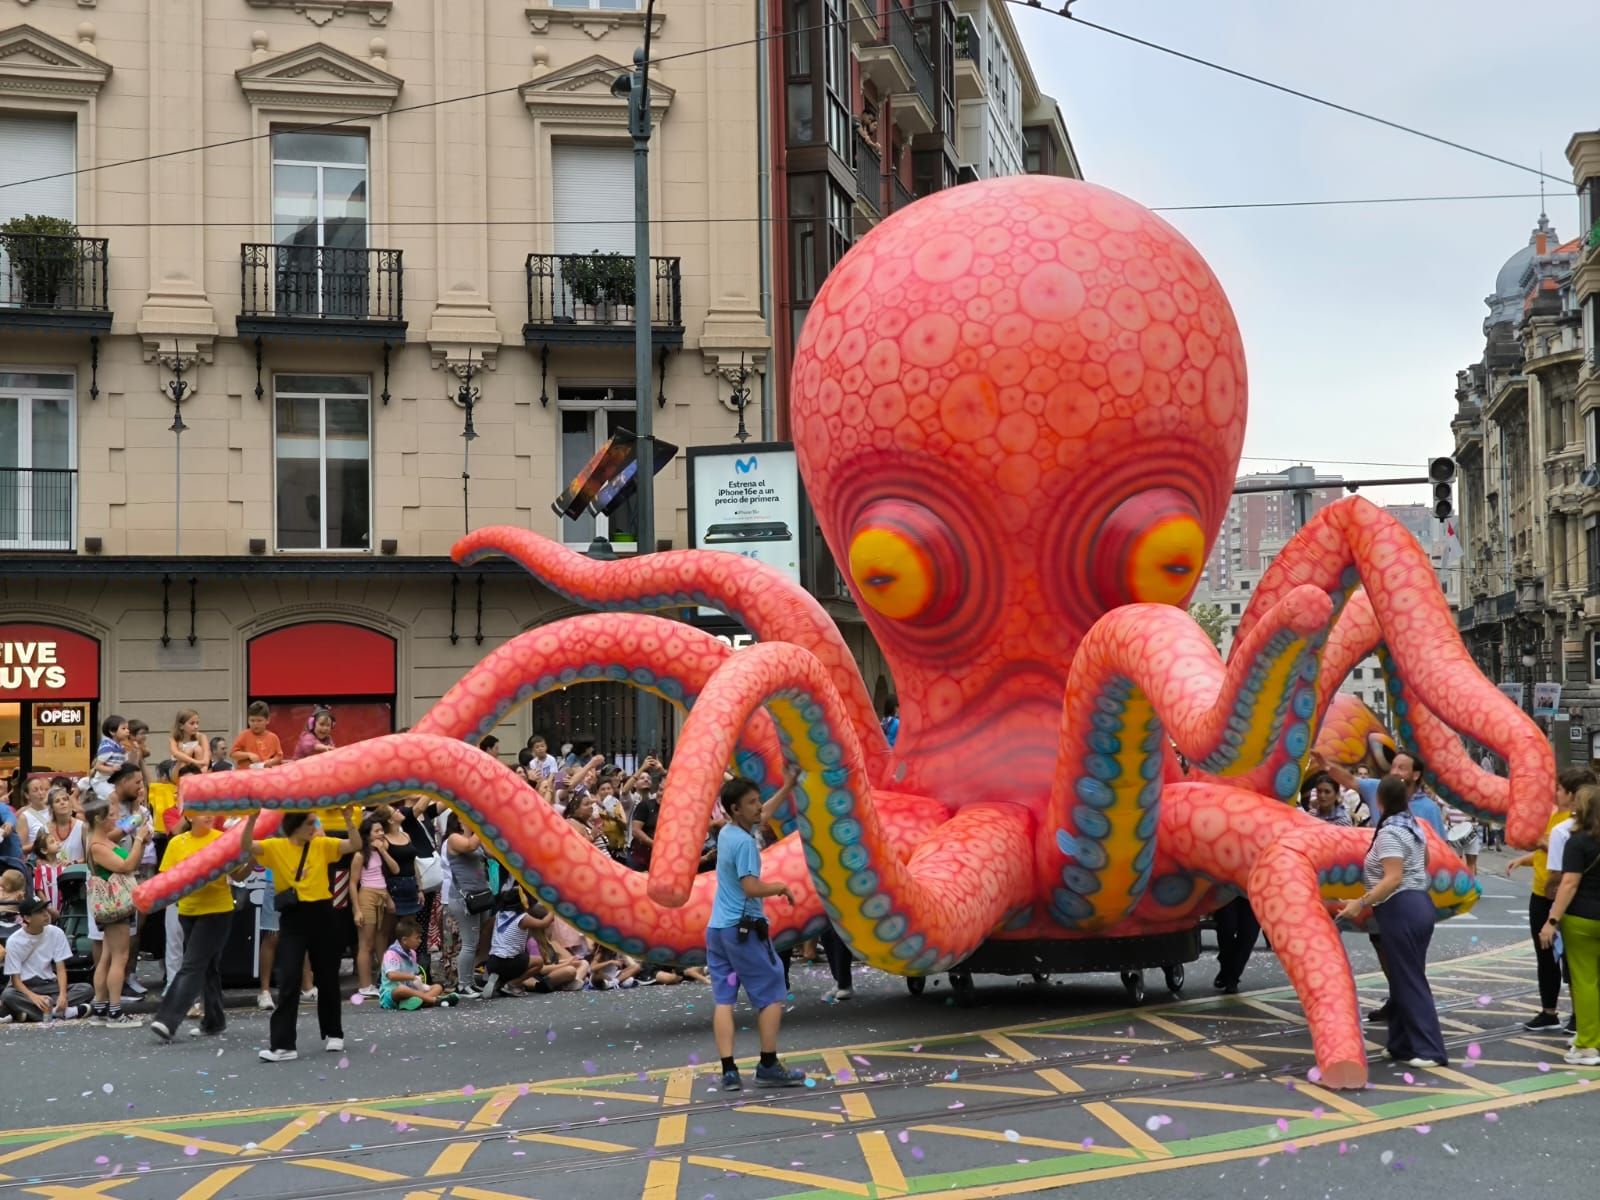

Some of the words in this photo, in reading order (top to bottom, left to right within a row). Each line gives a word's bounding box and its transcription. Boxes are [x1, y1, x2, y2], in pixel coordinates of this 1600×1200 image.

[714, 497, 738, 506] precio
[739, 495, 749, 503] de
[749, 495, 779, 504] primera
[0, 641, 57, 664] IVE
[0, 665, 66, 689] UYS
[40, 709, 81, 723] OPEN
